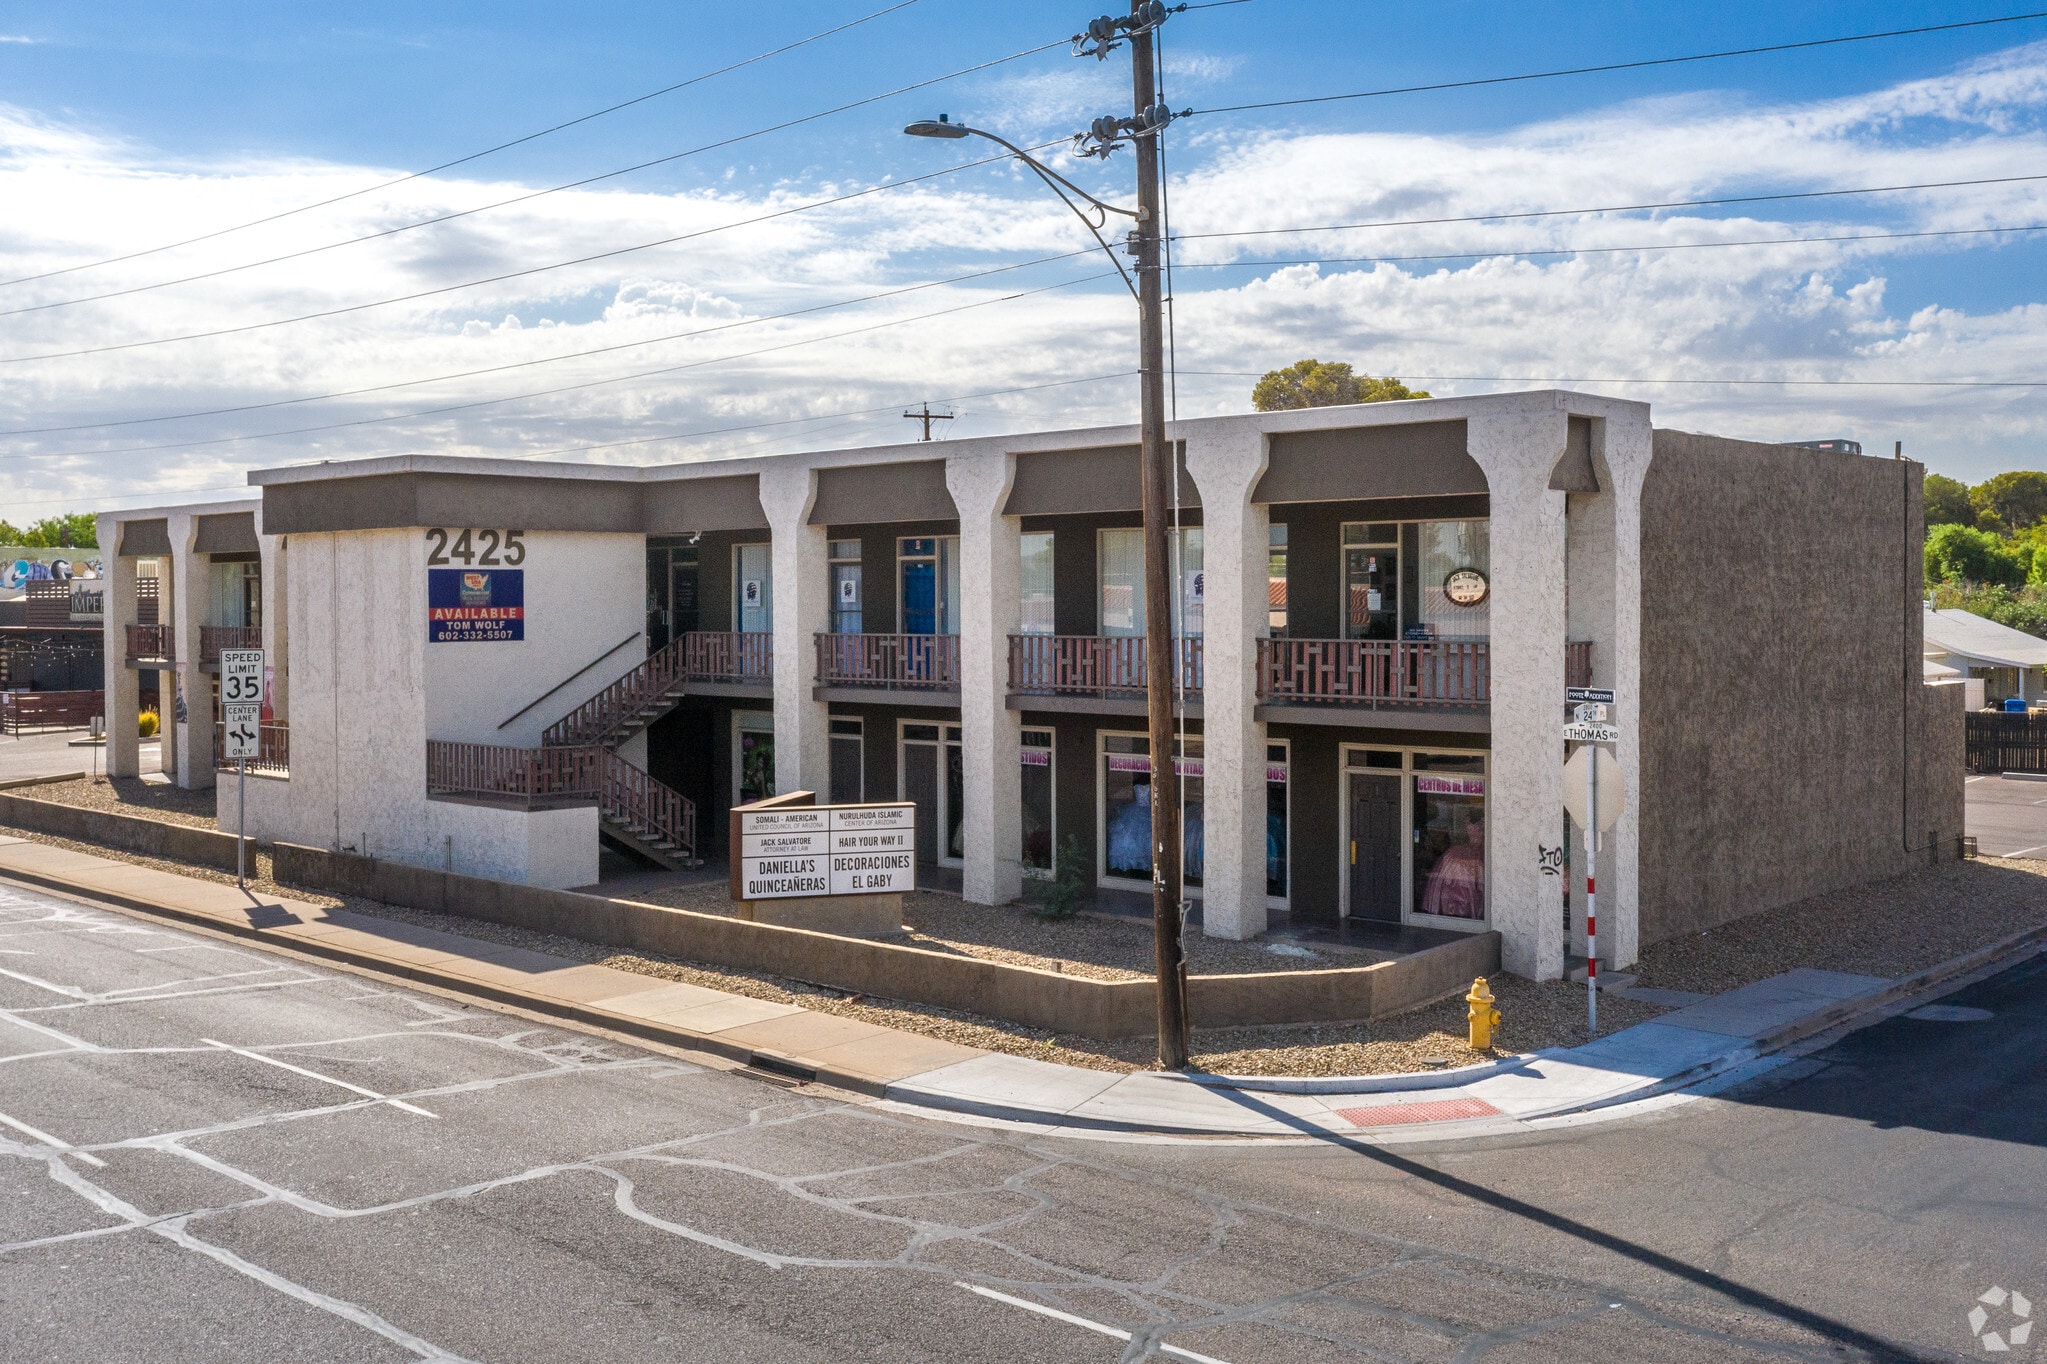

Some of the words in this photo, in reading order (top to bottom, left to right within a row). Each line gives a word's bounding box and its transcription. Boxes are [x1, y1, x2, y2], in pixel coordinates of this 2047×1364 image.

[426, 528, 525, 565] 2425
[435, 608, 516, 619] AVAILABLE
[447, 622, 470, 630] TOM
[475, 621, 505, 629] WOLF
[439, 631, 512, 640] 602-332-5507
[225, 654, 261, 662] SPEED
[228, 665, 256, 673] LIMIT
[227, 676, 259, 699] 35
[1569, 729, 1608, 740] THOMAS
[1419, 778, 1451, 792] CENTROS
[1453, 780, 1461, 793] DE
[1463, 781, 1483, 794] MESA
[755, 816, 779, 824] SOMALI
[786, 814, 817, 822] AMERICAN
[839, 812, 876, 820] NURULHUDA
[778, 837, 811, 845] SALVATORE
[839, 838, 856, 847] HAIR
[859, 837, 878, 846] YOUR
[880, 837, 896, 845] WAY
[760, 859, 815, 875] DANIELLA'S
[834, 855, 910, 871] DECORACIONES
[749, 876, 825, 894] QUINCEAÑERAS
[852, 876, 863, 888] EL
[867, 874, 892, 888] GABY
